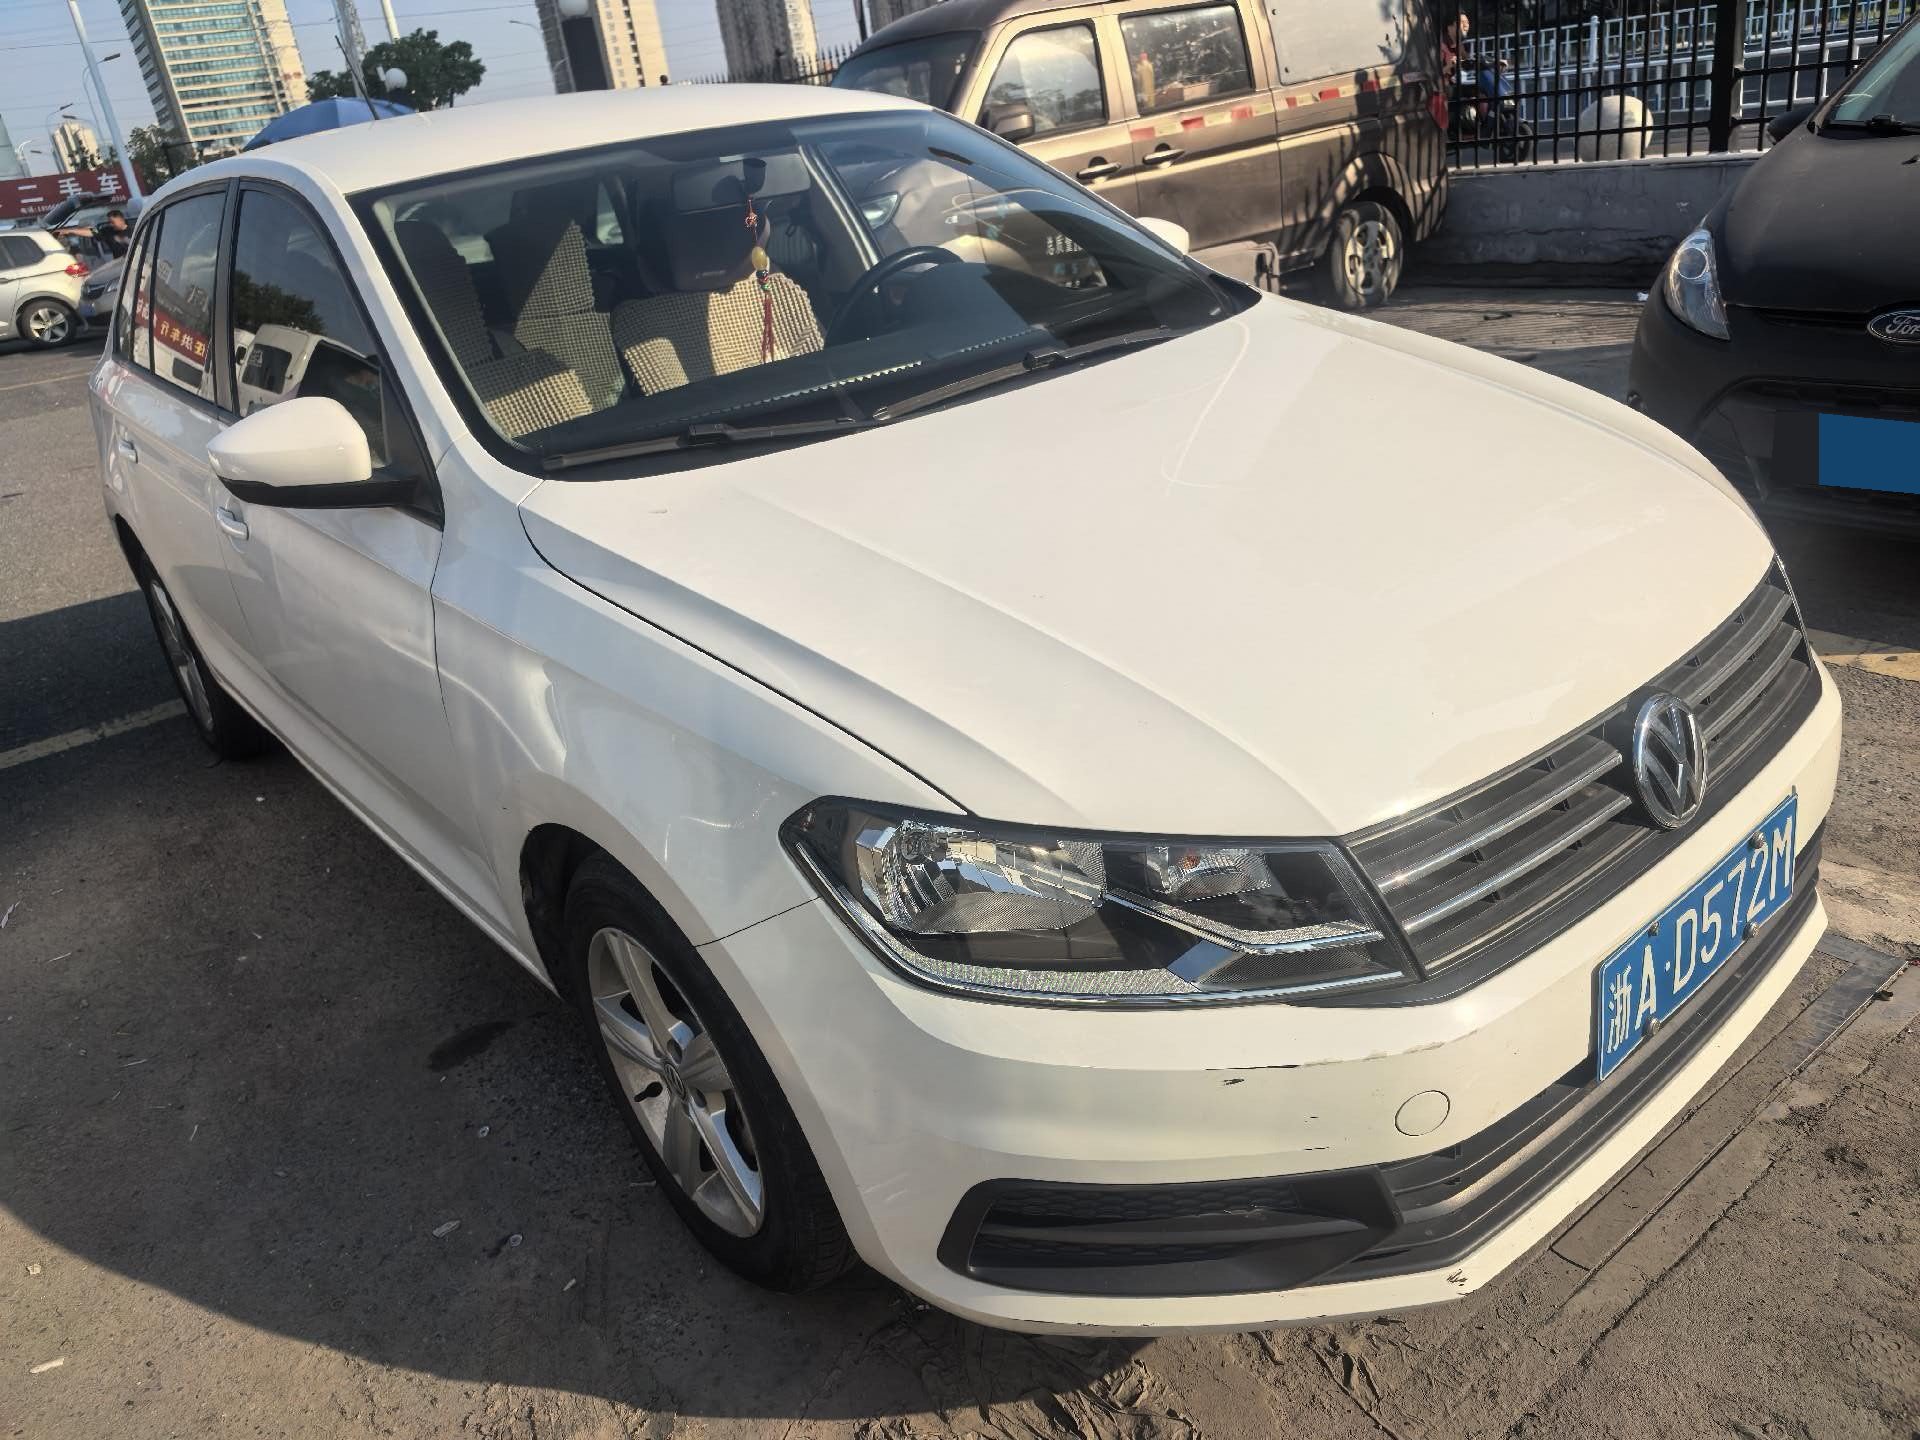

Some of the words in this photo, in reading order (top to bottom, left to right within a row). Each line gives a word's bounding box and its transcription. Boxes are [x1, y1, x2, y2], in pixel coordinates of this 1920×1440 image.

[17, 172, 122, 204] 二手车
[1886, 315, 1920, 335] For
